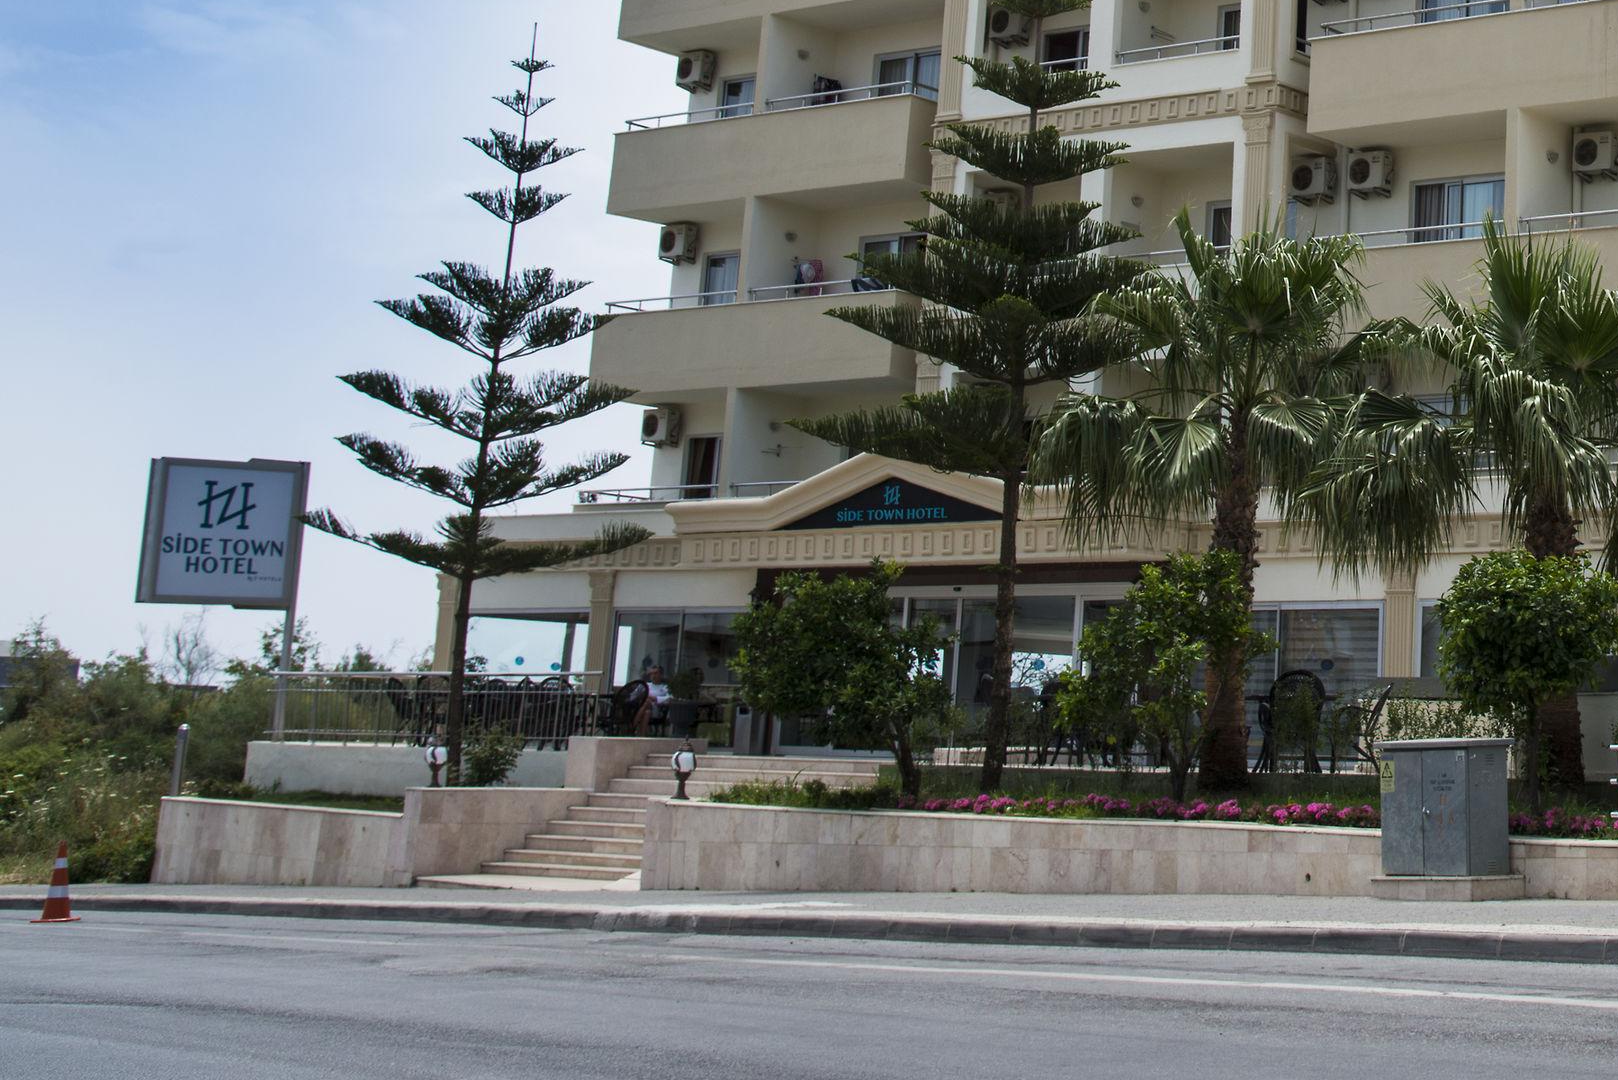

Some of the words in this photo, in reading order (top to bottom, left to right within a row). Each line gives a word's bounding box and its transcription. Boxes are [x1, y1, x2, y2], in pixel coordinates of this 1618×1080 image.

[866, 508, 904, 521] TOWN
[906, 507, 948, 520] HOTEL
[219, 539, 284, 557] TOWN
[185, 556, 258, 575] HOTEL
